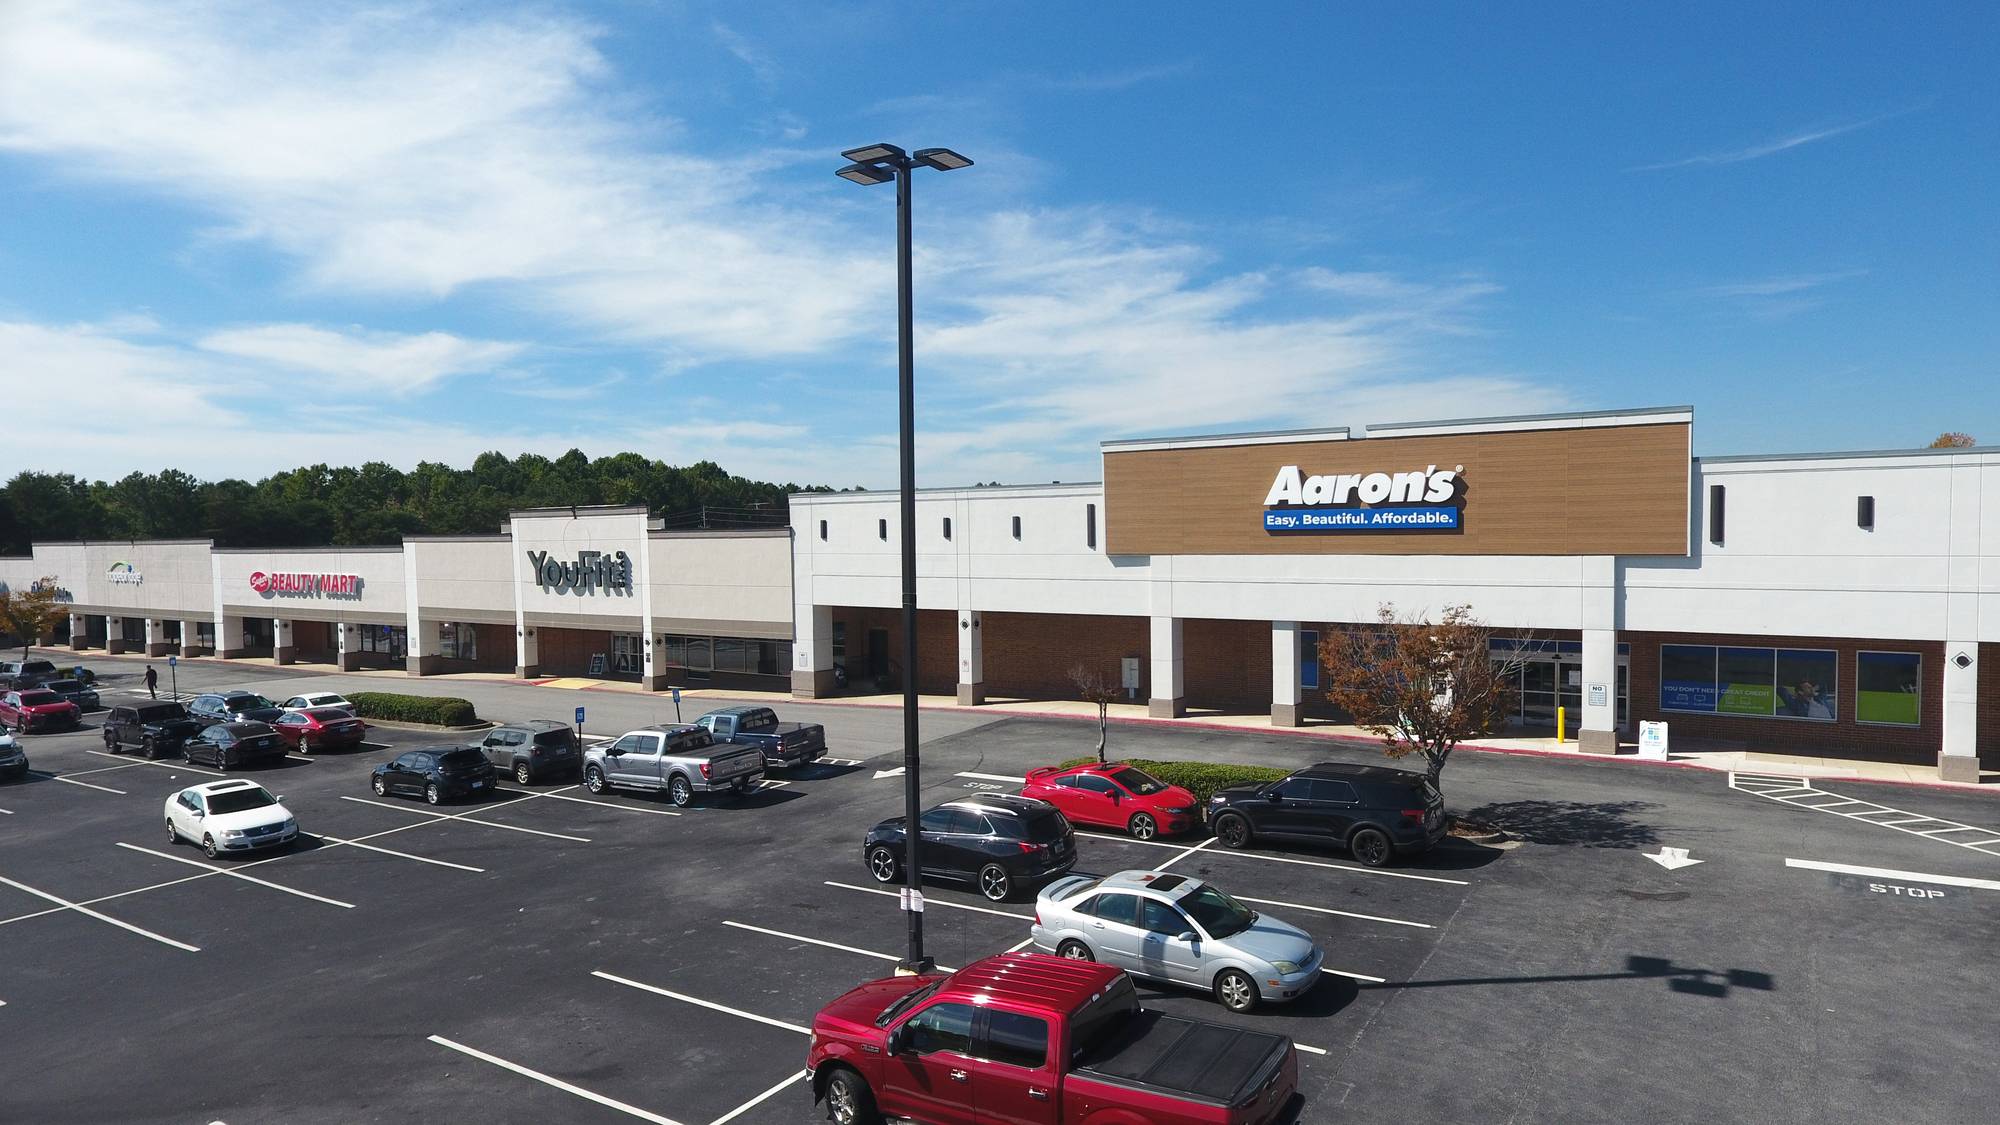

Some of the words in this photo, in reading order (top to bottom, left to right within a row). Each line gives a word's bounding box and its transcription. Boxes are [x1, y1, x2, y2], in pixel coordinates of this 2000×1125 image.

[1263, 464, 1457, 506] Aaron's
[1266, 514, 1299, 527] Easy.
[1302, 512, 1368, 525] Beautiful.
[1371, 511, 1453, 525] Affordable.
[527, 551, 616, 588] YouFit
[271, 573, 317, 591] BEAUTY
[320, 574, 358, 593] MART
[963, 781, 1003, 790] STOP
[1869, 883, 1945, 899] STOP
